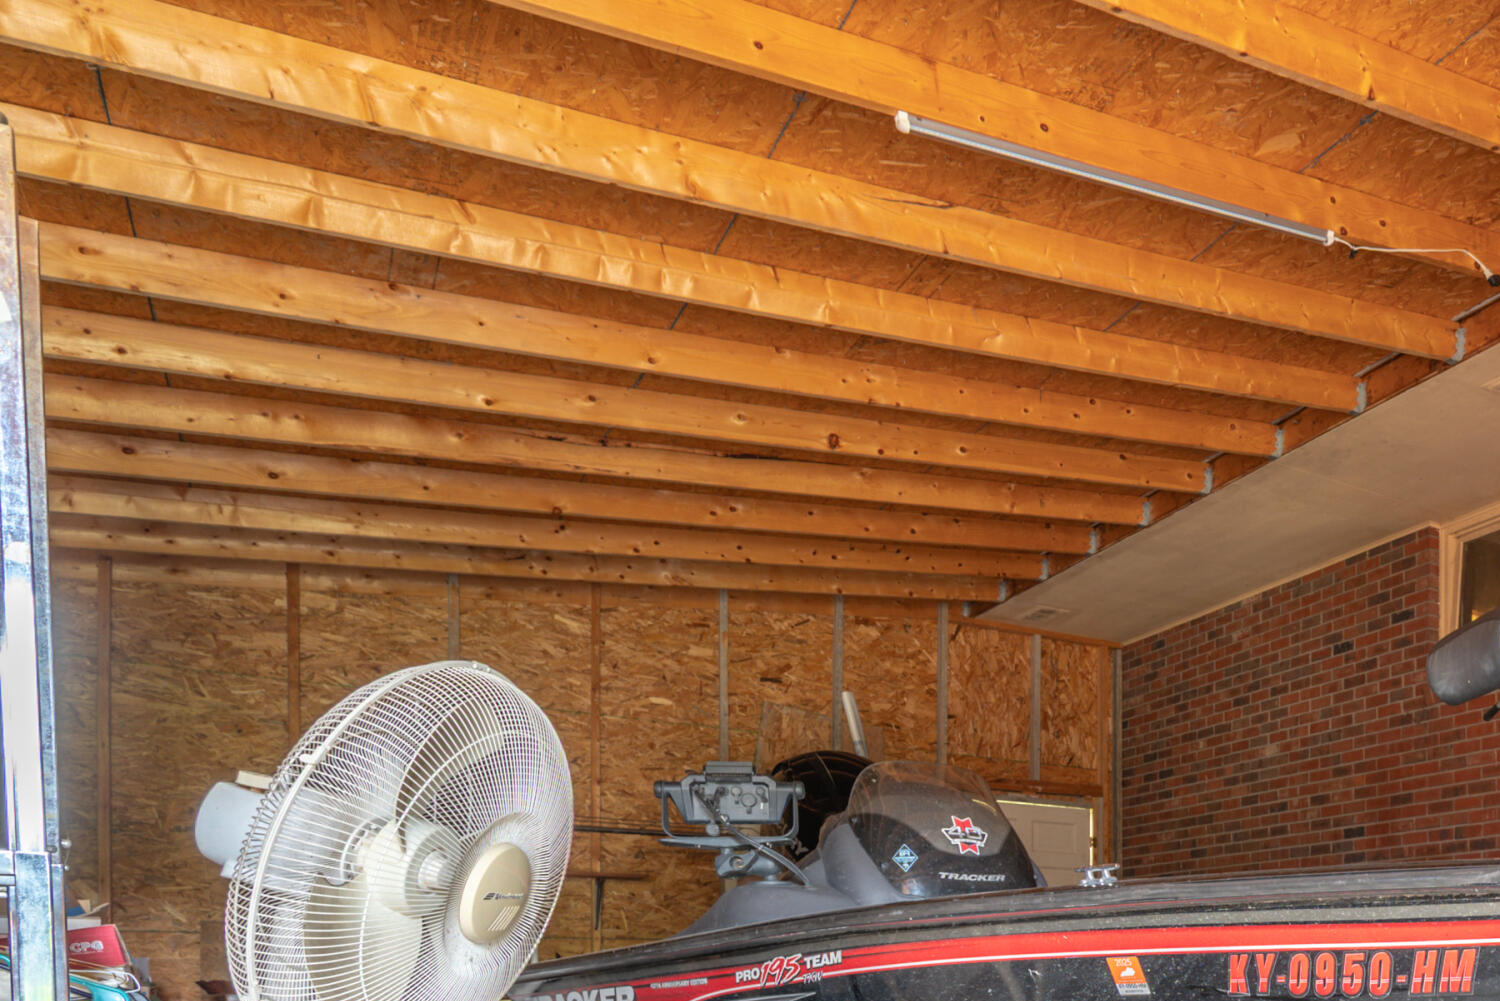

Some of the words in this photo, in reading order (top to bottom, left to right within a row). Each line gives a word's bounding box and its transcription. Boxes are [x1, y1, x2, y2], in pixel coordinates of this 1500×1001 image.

[938, 871, 1006, 882] TRACKER
[735, 967, 760, 984] PRO
[760, 953, 802, 986] 195
[803, 950, 842, 969] TEAM
[1229, 948, 1478, 997] KY-0950-HM
